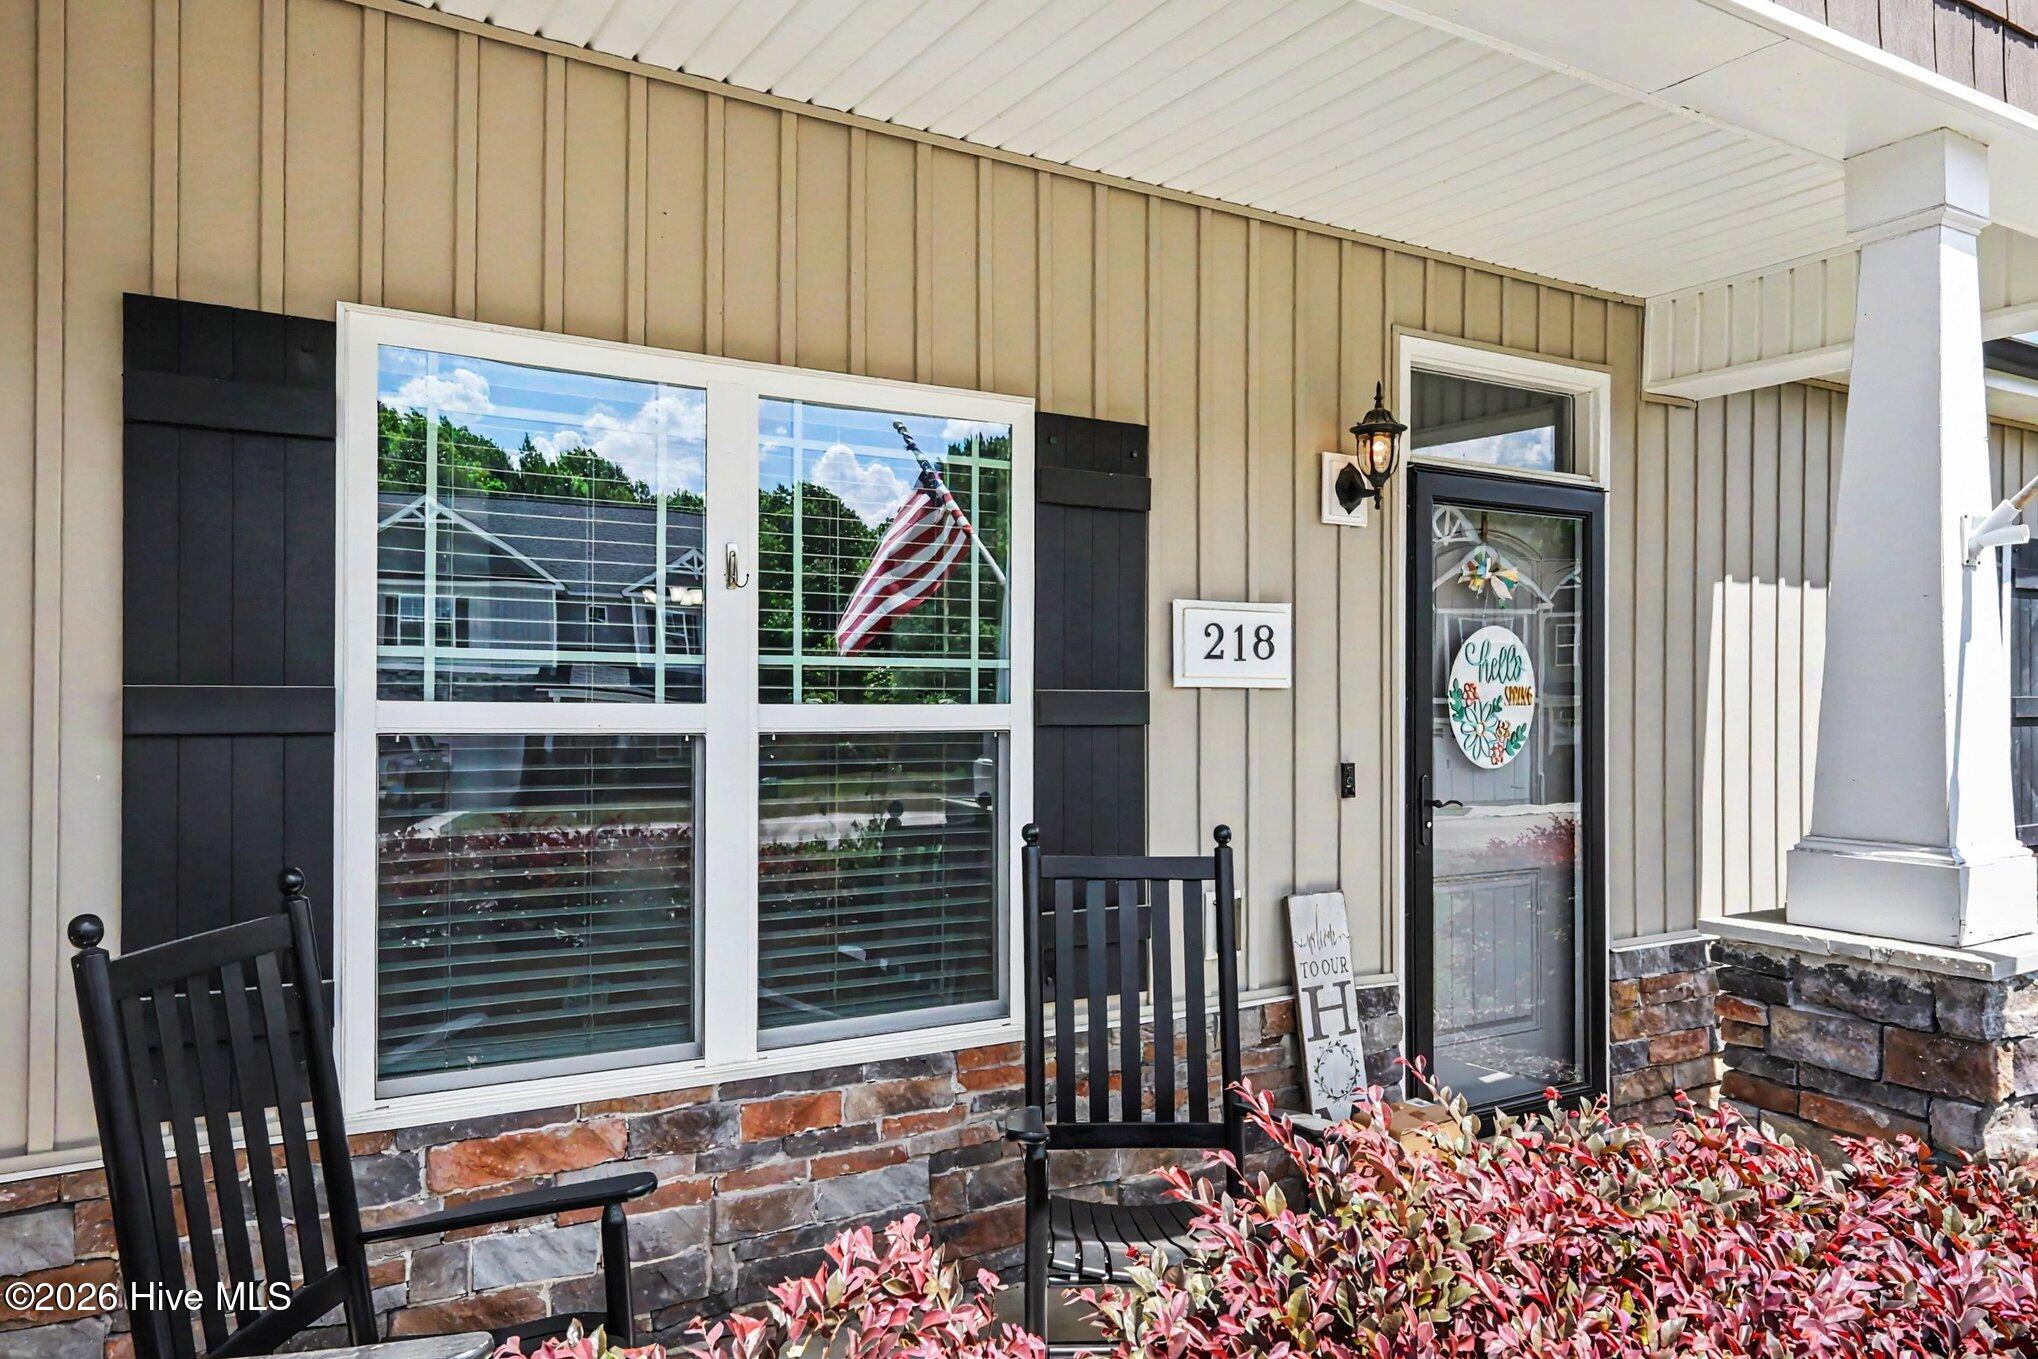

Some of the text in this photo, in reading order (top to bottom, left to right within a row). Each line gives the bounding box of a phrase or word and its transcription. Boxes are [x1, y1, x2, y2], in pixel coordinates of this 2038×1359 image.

[1203, 622, 1275, 661] 218
[1464, 638, 1526, 684] hello
[1504, 685, 1533, 707] SPRING
[1300, 956, 1349, 979] TO OUR
